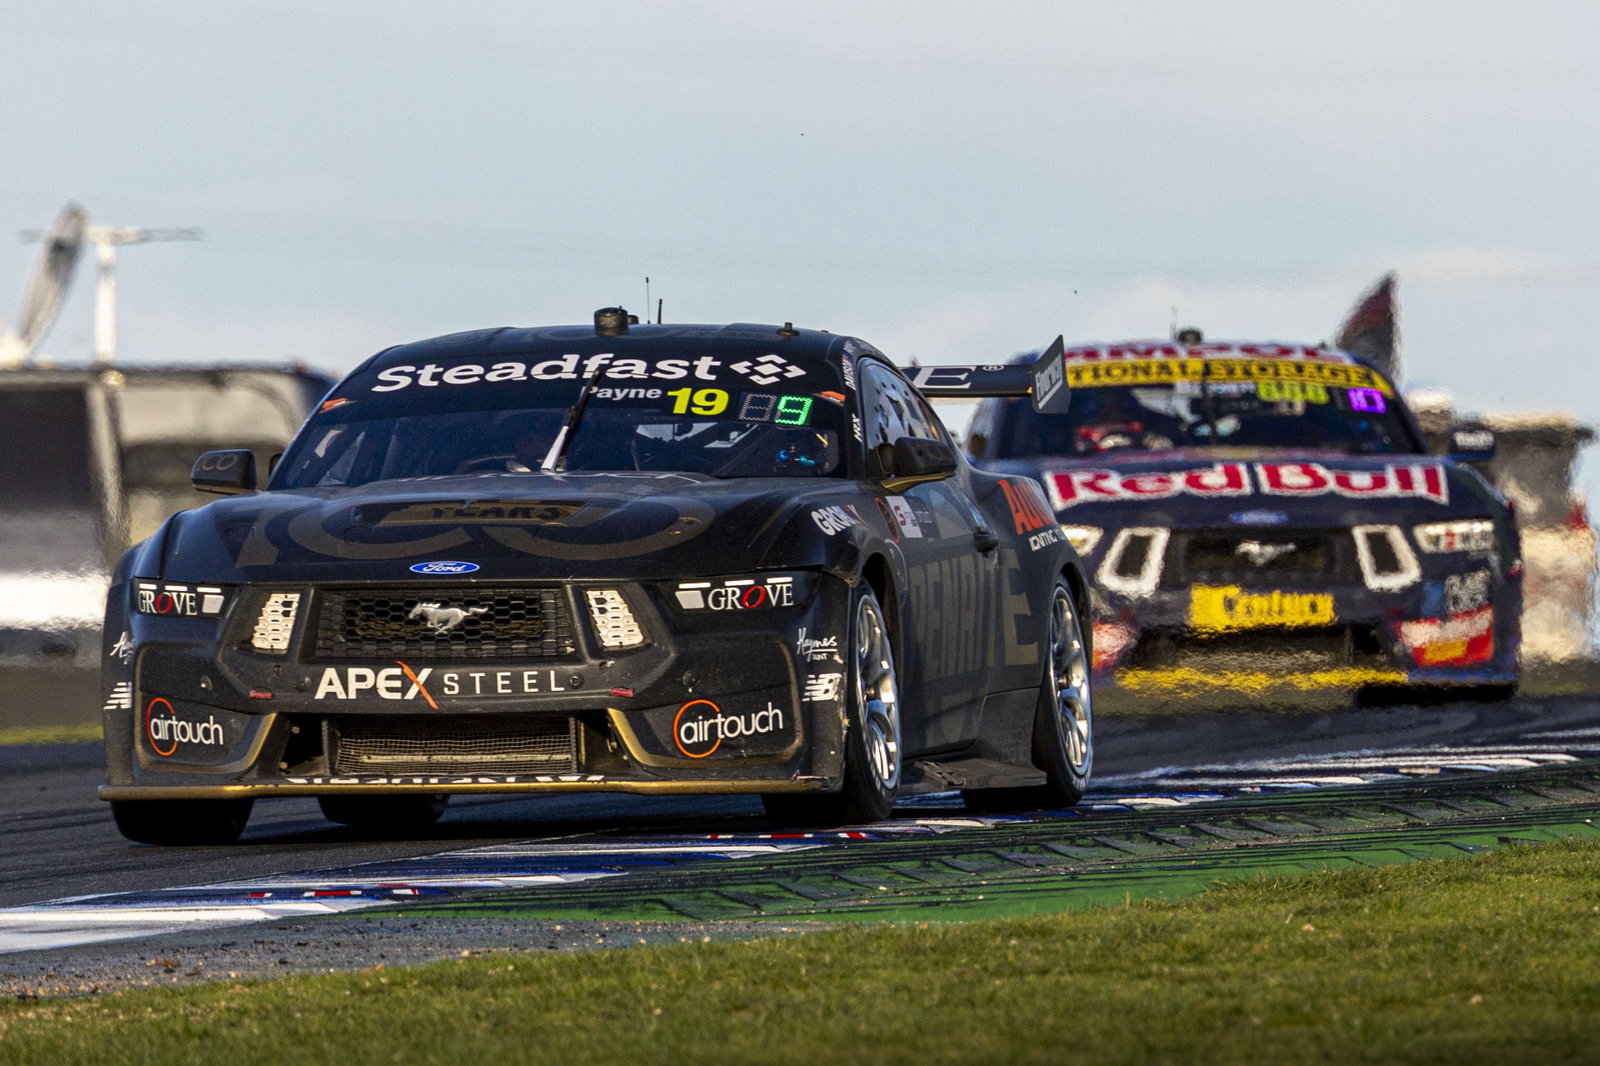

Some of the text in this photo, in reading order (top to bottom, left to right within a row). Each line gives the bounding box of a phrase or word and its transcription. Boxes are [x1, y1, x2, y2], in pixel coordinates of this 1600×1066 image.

[371, 353, 721, 392] Steadfast
[1069, 361, 1204, 383] TIONAL
[667, 387, 729, 417] 19
[1045, 462, 1449, 507] Red Bull
[420, 561, 468, 574] Ford
[138, 590, 197, 616] GROVE
[707, 584, 794, 611] GROVE
[313, 661, 565, 710] APEX STEEL
[150, 714, 224, 746] airtouch
[680, 701, 784, 745] airtouch
